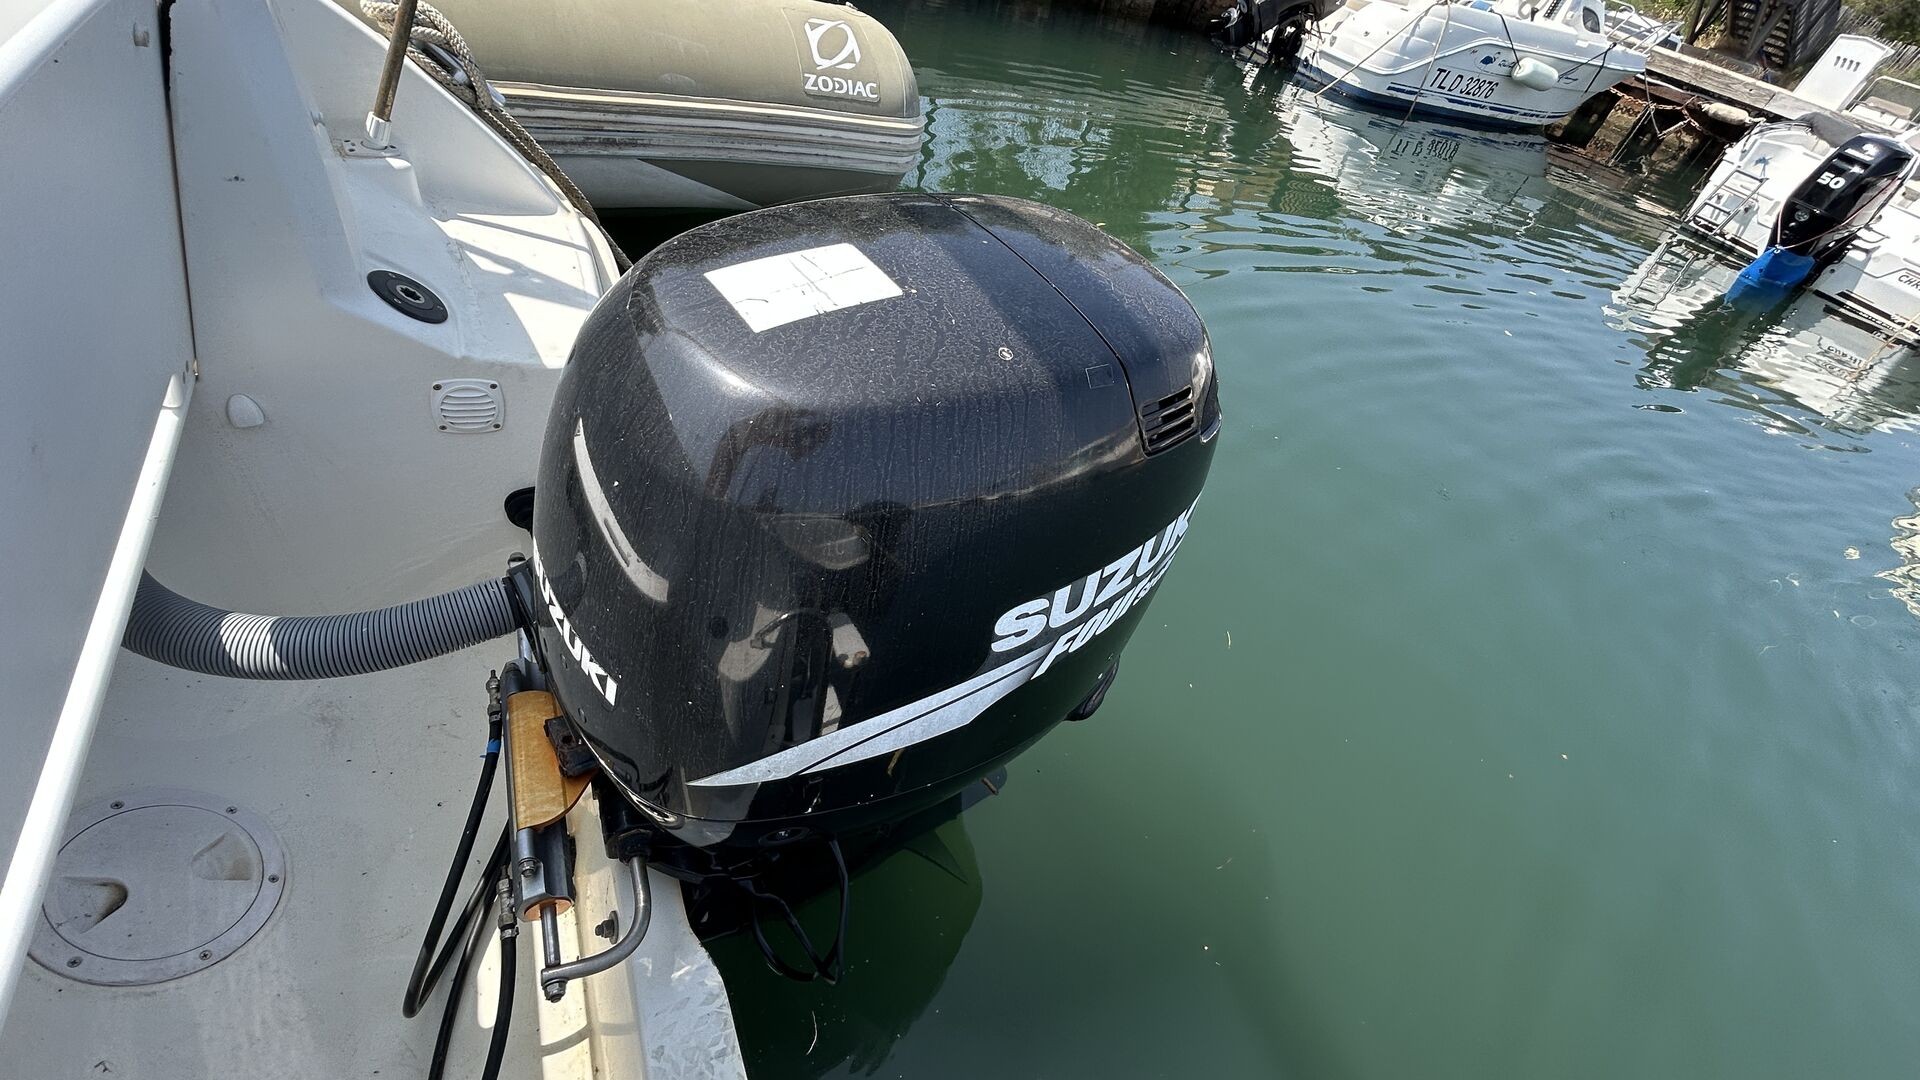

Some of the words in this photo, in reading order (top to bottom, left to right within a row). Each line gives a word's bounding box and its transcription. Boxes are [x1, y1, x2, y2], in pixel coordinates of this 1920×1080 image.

[803, 73, 878, 98] ZODIAC
[1460, 76, 1499, 100] 32876
[1816, 172, 1846, 190] 50
[1898, 274, 1920, 292] CHR
[991, 492, 1201, 653] SUZUK
